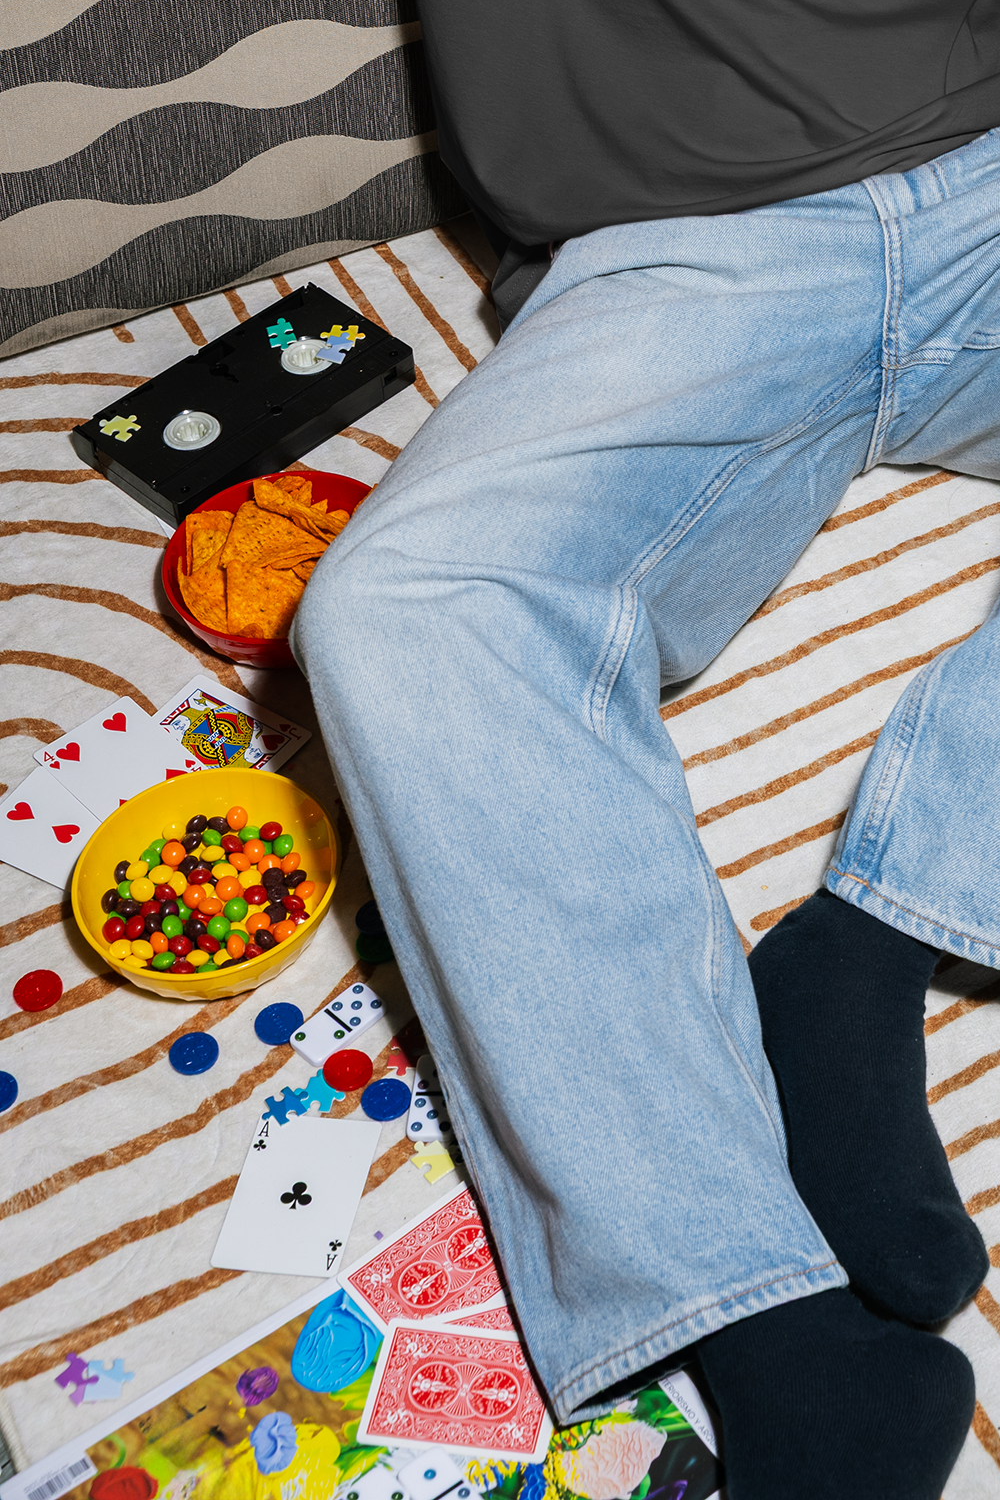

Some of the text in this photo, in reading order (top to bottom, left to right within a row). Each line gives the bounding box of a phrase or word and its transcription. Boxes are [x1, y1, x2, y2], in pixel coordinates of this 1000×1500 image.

[43, 751, 55, 762] 4
[258, 1120, 270, 1137] A
[326, 1253, 338, 1271] A
